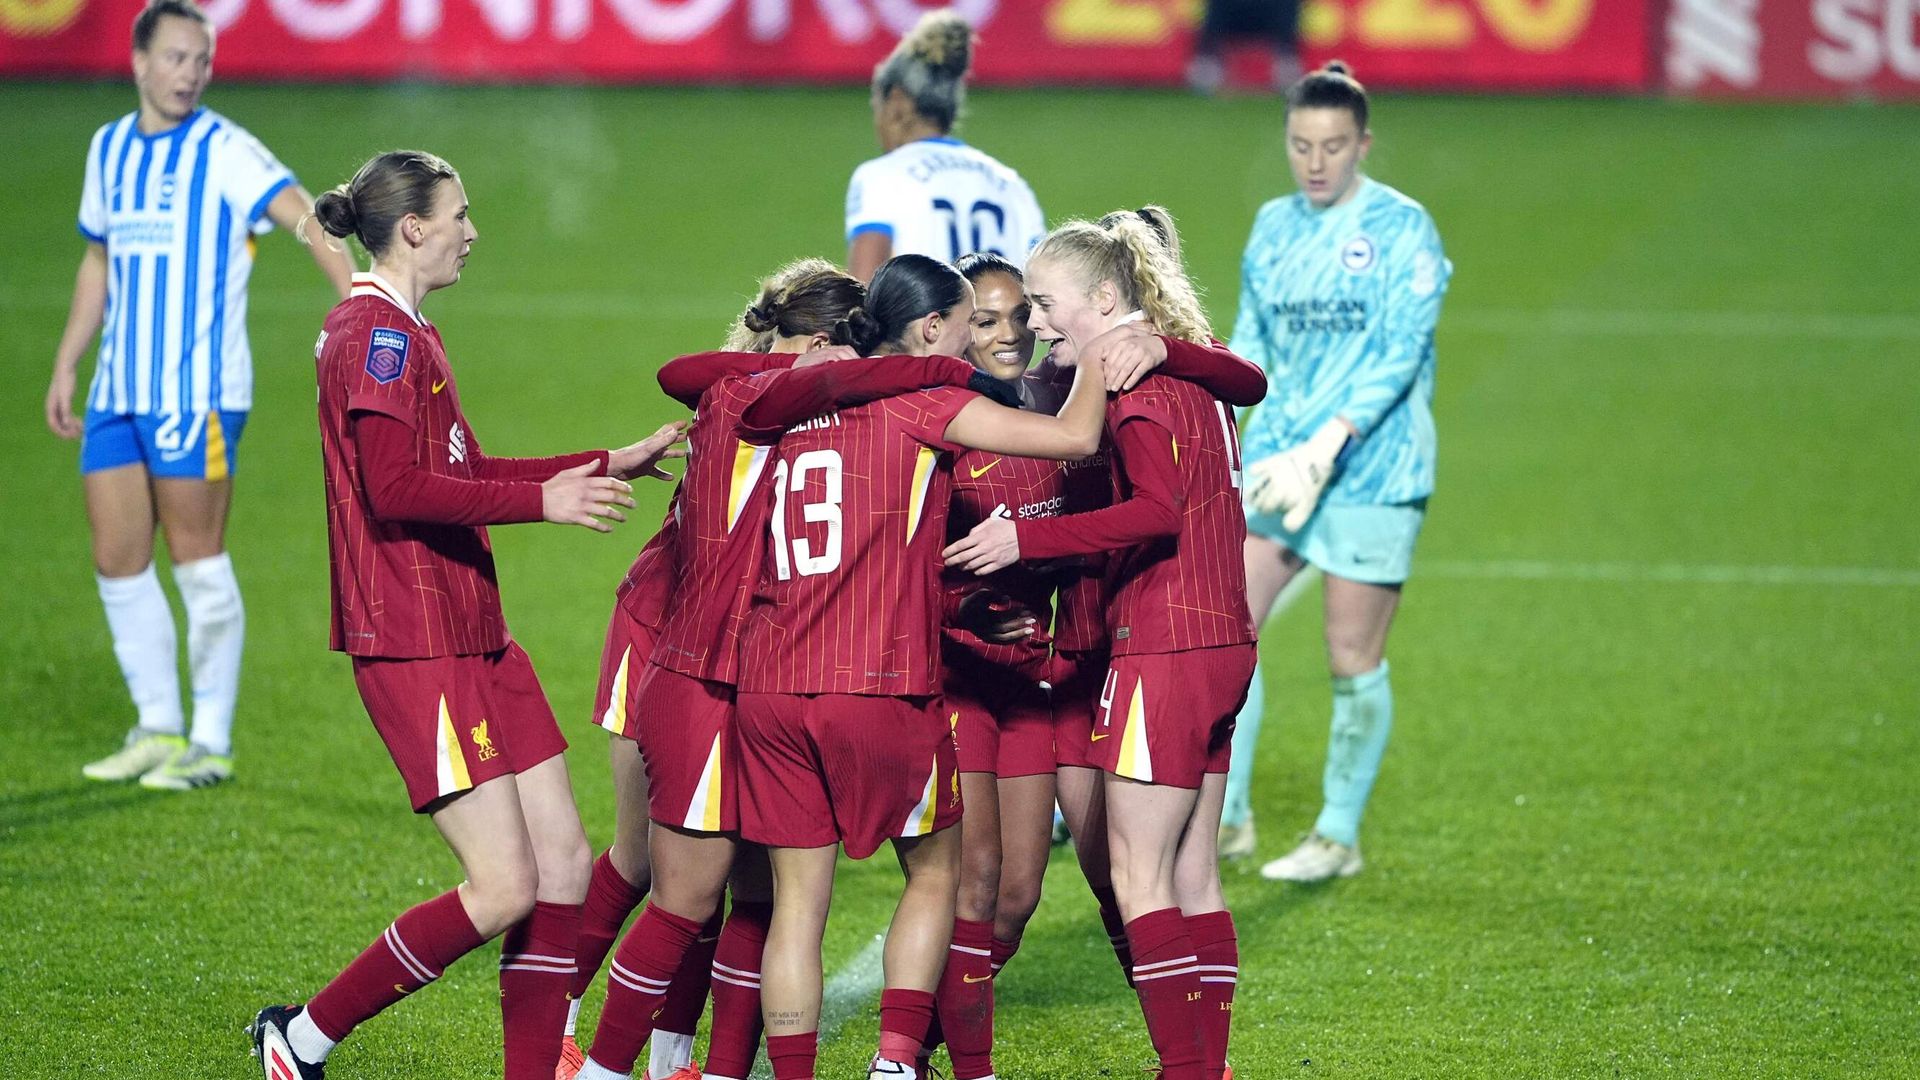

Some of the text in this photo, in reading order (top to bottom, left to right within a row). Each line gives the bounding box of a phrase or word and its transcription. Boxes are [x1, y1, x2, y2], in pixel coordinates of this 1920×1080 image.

[1272, 300, 1366, 315] AMERICAN
[771, 449, 843, 581] 13
[1100, 668, 1118, 726] 4
